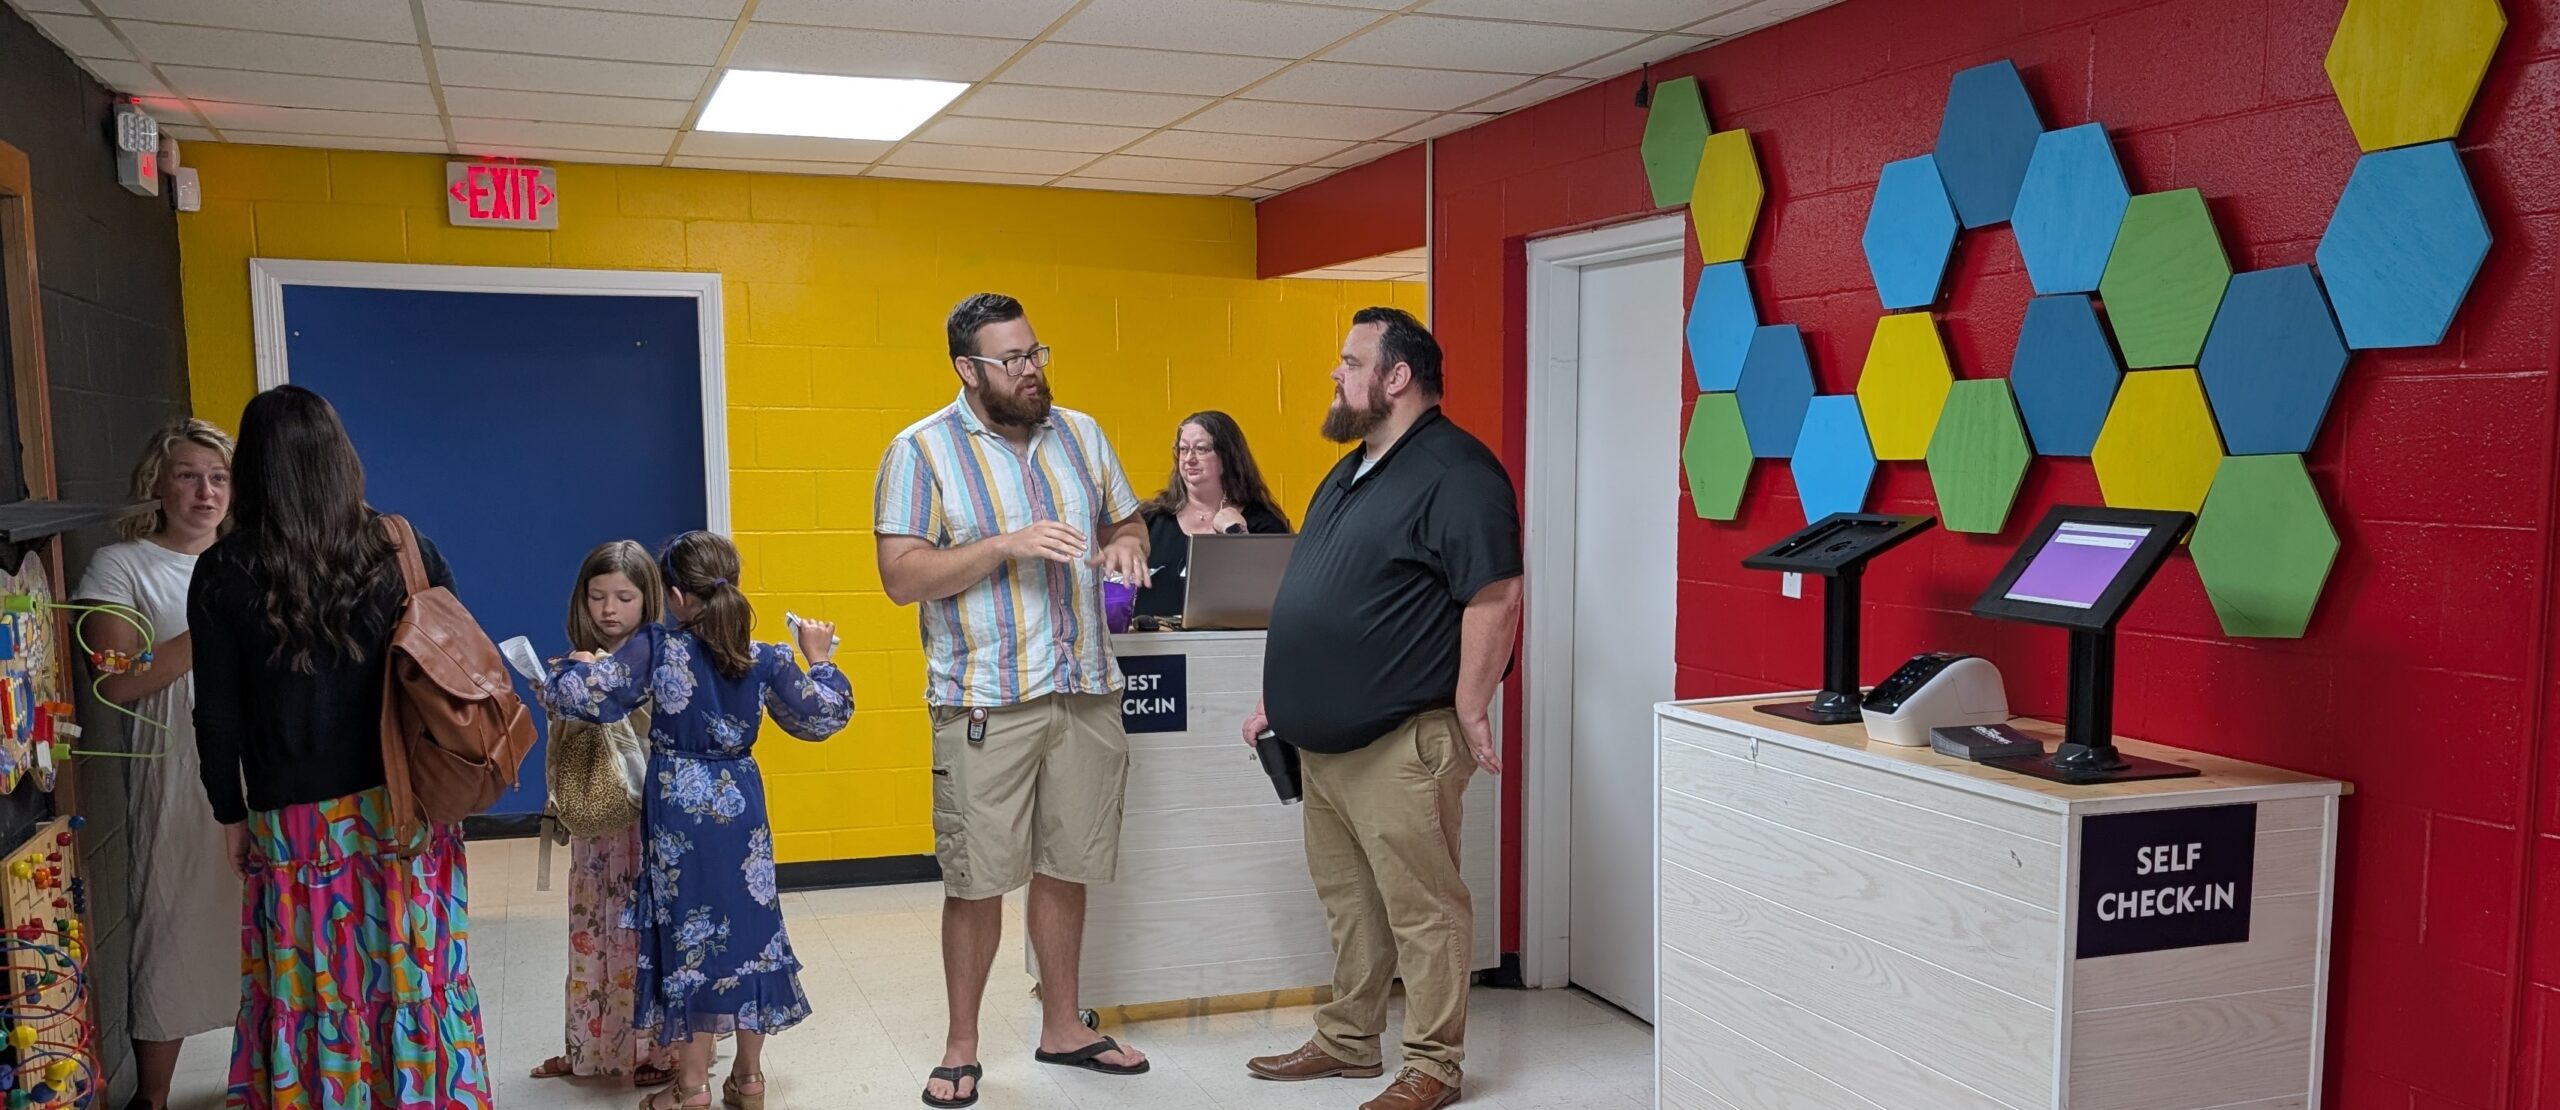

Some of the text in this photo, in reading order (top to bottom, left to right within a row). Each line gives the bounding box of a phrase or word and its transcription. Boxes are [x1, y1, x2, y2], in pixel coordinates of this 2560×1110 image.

[467, 165, 540, 221] EXIT
[1123, 674, 1162, 691] EST
[1122, 697, 1176, 715] CK-IN
[2136, 842, 2202, 875] SELF
[2096, 881, 2235, 922] CHECK-IN
